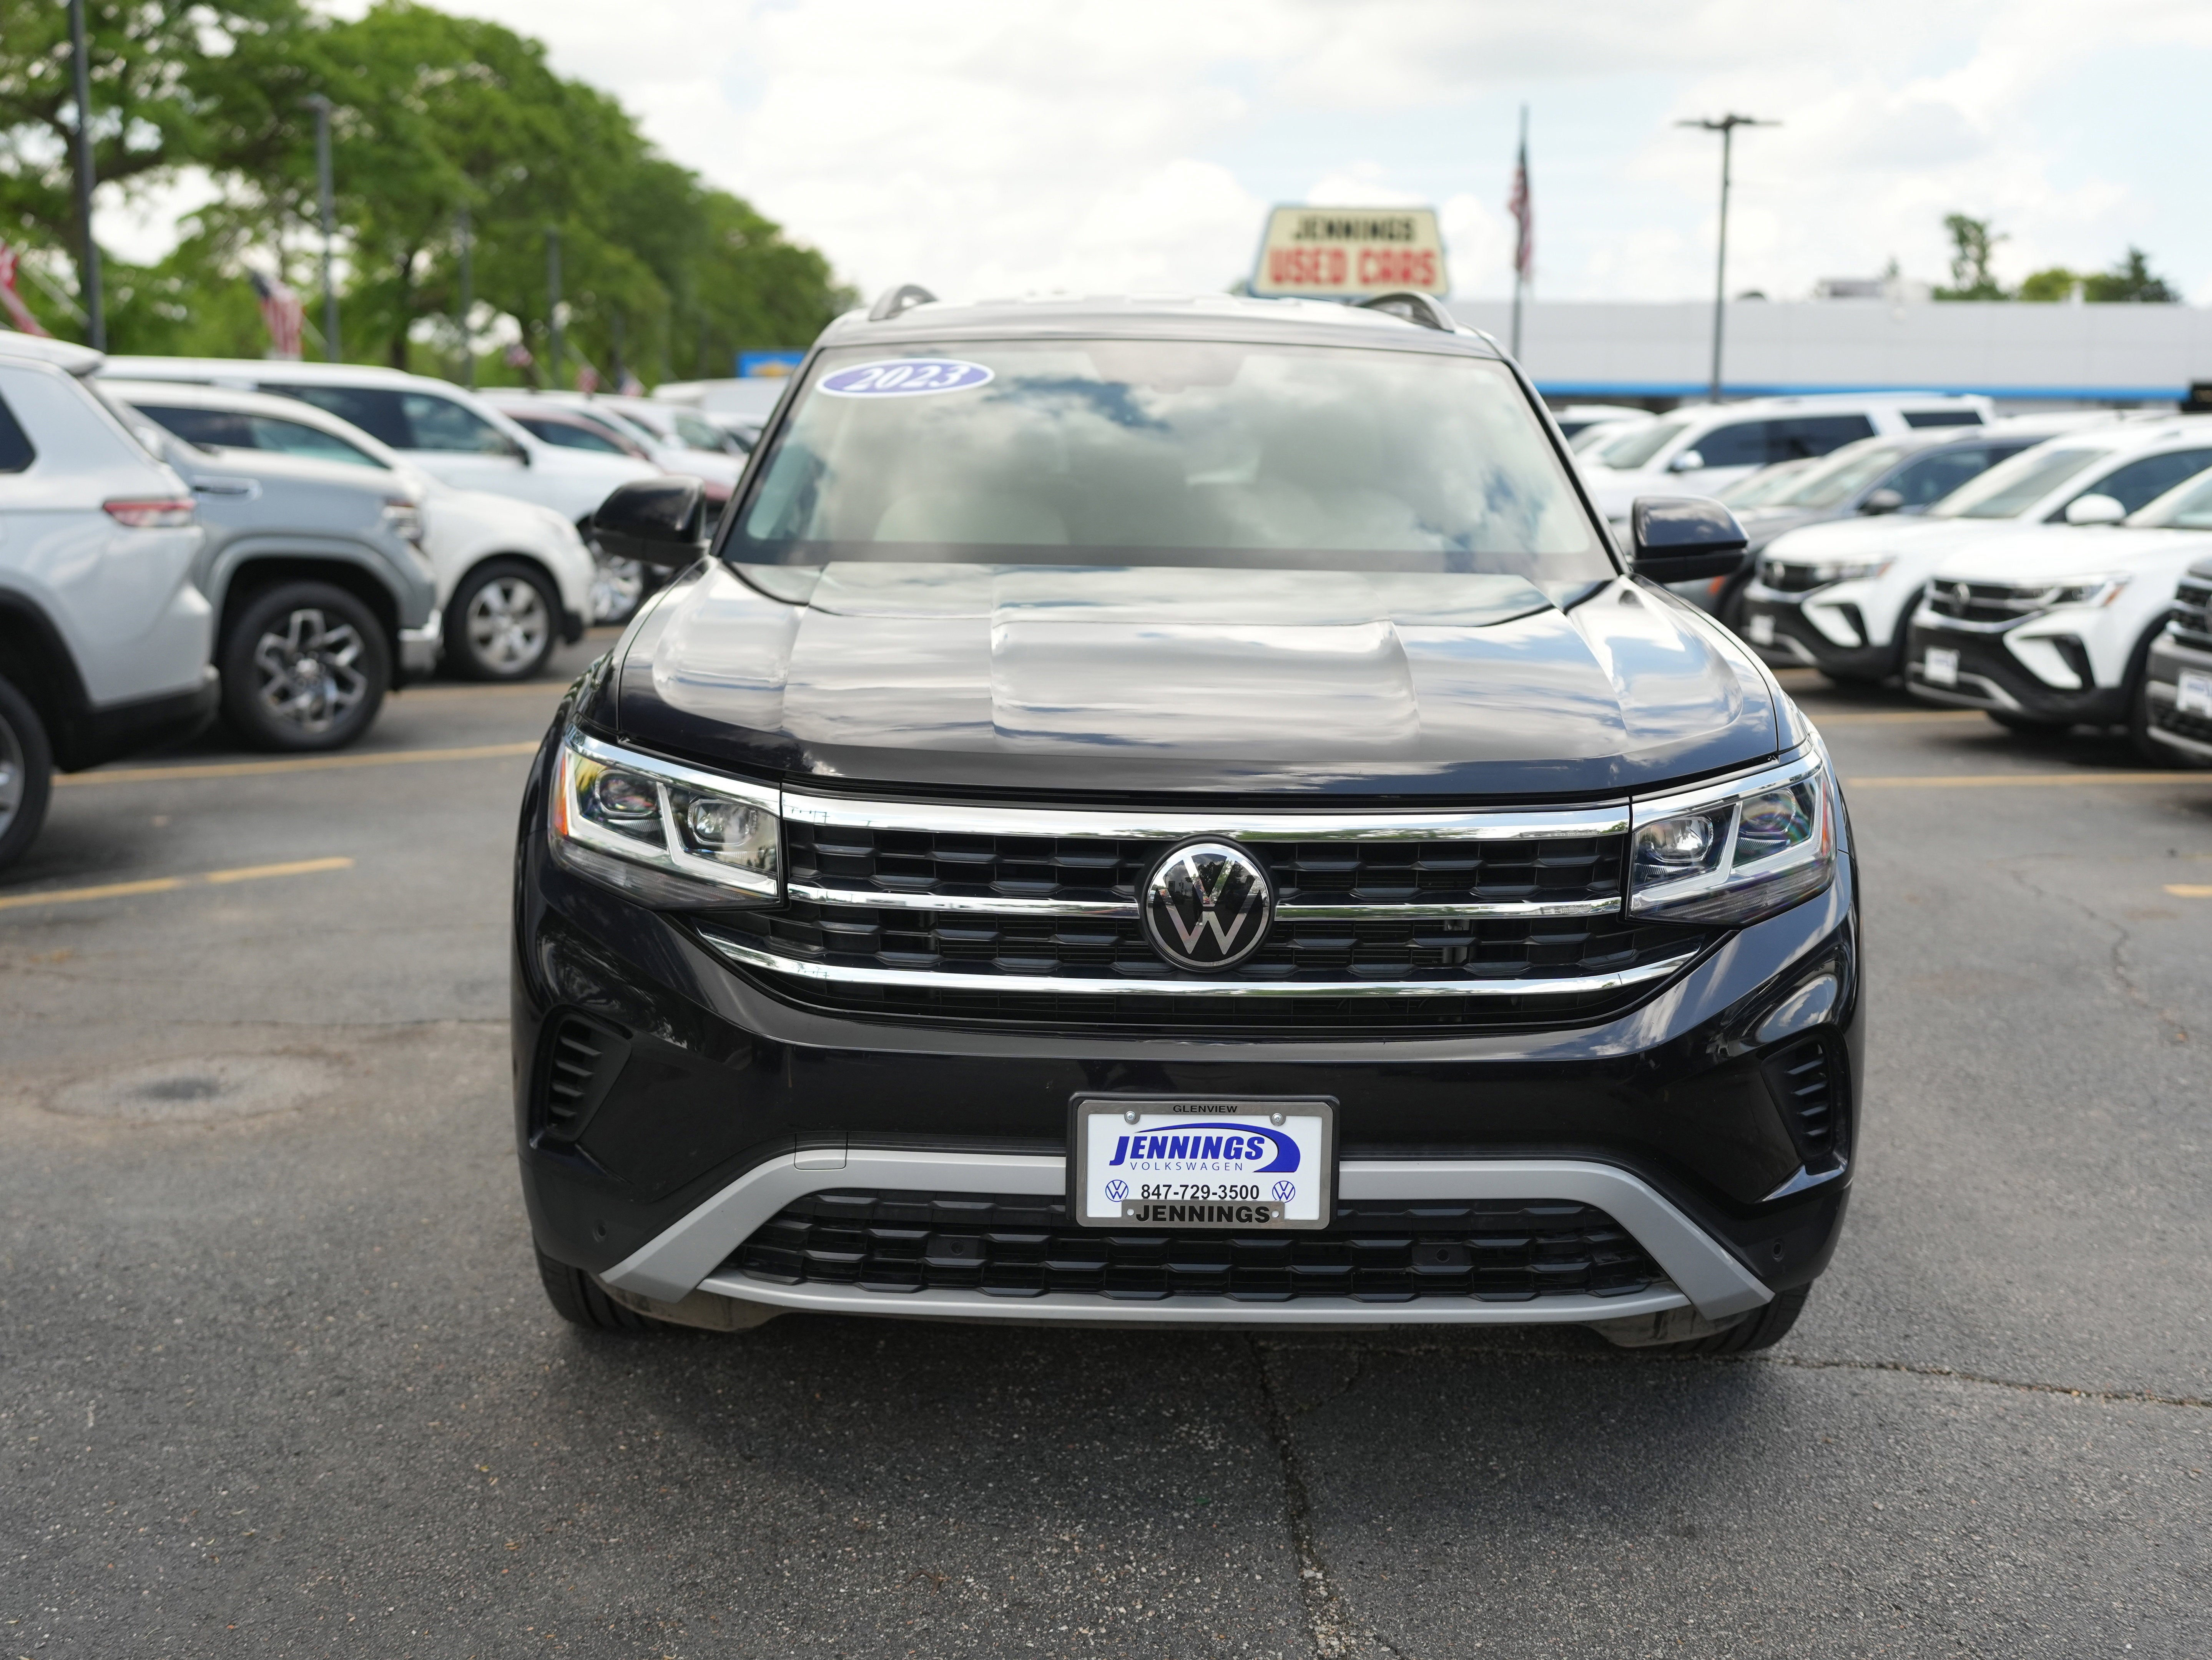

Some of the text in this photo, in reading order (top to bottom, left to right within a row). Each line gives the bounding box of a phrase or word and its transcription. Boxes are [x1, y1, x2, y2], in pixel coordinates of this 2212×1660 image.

[1270, 247, 1437, 285] USED CARS
[842, 364, 971, 391] 2023
[1172, 1105, 1238, 1113] GLENVIEW
[1108, 1136, 1265, 1166] JENNINGS
[1130, 1162, 1243, 1171] VOLKSWAGEN
[1141, 1184, 1260, 1200] 847-729-3500
[1136, 1205, 1270, 1223] JENNINGS
